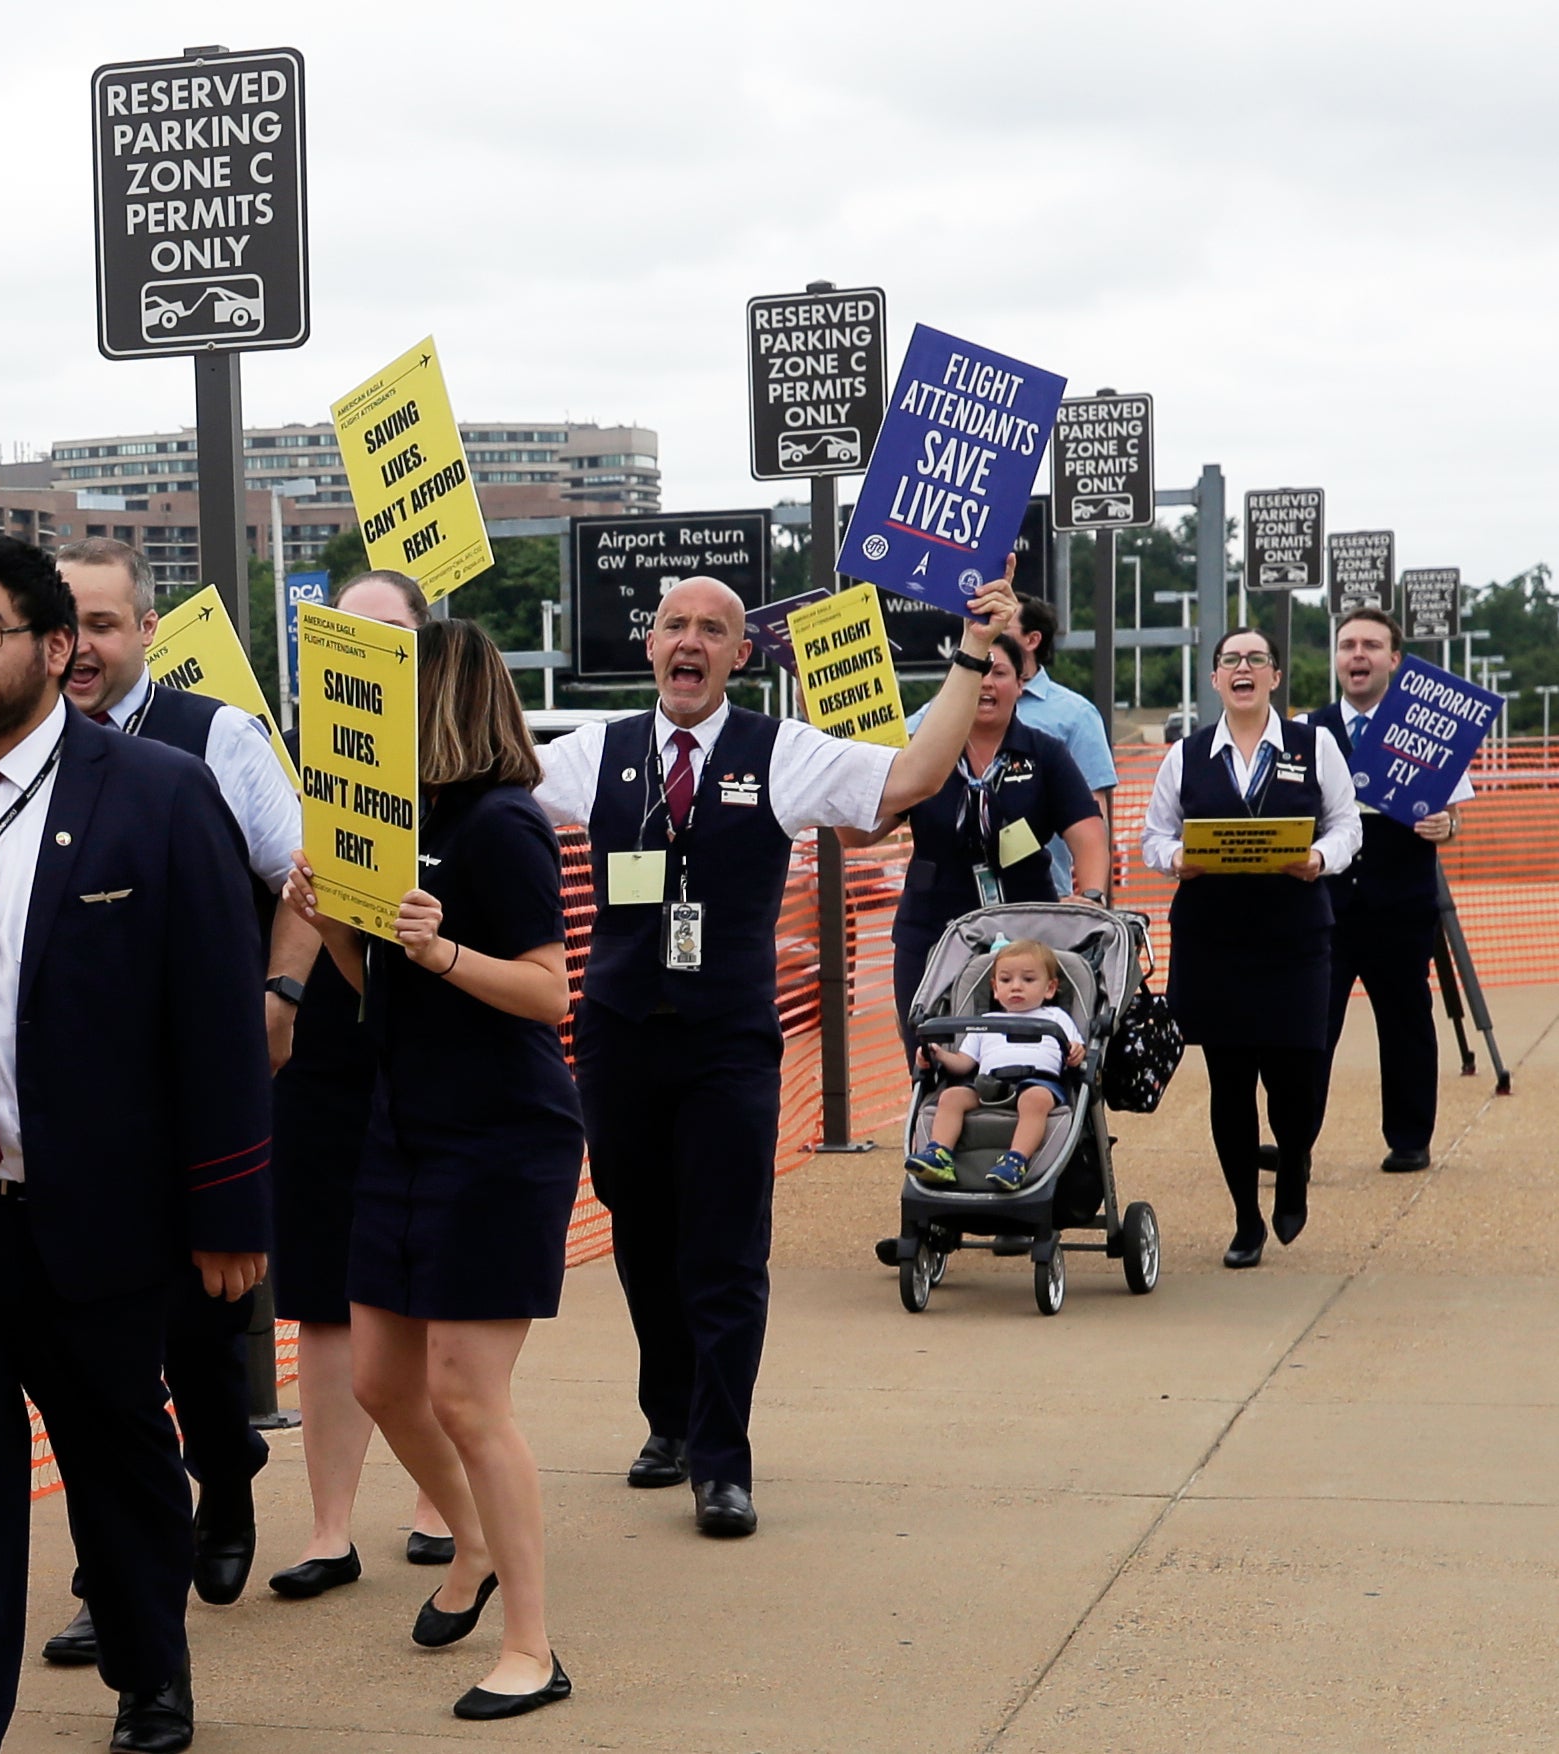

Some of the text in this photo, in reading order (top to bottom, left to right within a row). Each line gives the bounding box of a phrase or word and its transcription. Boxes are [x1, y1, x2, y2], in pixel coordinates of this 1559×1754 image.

[107, 70, 287, 117] RESERVED
[114, 111, 282, 156] PARKING
[126, 152, 273, 195] ZONE C
[126, 192, 274, 235] PERMITS
[151, 234, 250, 273] ONLY
[755, 300, 875, 330] RESERVED
[759, 326, 872, 355] PARKING
[768, 351, 867, 379] ZONE C
[768, 377, 867, 404] PERMITS
[942, 353, 1024, 408] FLIGHT
[337, 380, 385, 417] AMERICAN EAGLE
[341, 388, 397, 430] FLIGHT ATTENDANTS
[1056, 402, 1145, 423] RESERVED
[364, 400, 420, 455] SAVING
[785, 403, 851, 428] ONLY
[899, 380, 1040, 456] ATTENDANTS
[1059, 420, 1142, 441] PARKING
[916, 430, 997, 496] SAVE
[1065, 438, 1139, 459] ZONE C
[381, 443, 427, 488] LIVES.
[1065, 456, 1139, 477] PERMITS
[1077, 475, 1126, 494] ONLY
[363, 458, 466, 544] CAN'T AFFORD
[889, 475, 990, 550] LIVES!
[1250, 493, 1319, 509] RESERVED
[1251, 507, 1317, 522] PARKING
[402, 520, 447, 564] RENT.
[598, 528, 744, 550] Airport Return
[1255, 535, 1313, 550] PERMITS
[1256, 521, 1313, 536] ZONE C
[1331, 535, 1390, 547] RESERVED
[598, 550, 749, 569] GW Parkway South
[1264, 549, 1303, 562] ONLY
[1333, 547, 1388, 559] PARKING
[1337, 558, 1385, 570] ZONE C
[620, 585, 634, 596] To
[1336, 570, 1385, 582] PERMITS
[1344, 582, 1377, 592] ONLY
[289, 584, 323, 600] DCA
[304, 614, 335, 632] AMERICAN
[335, 622, 356, 636] EAGLE
[805, 618, 871, 660] PSA FLIGHT
[304, 633, 366, 659] FLIGHT ATTENDANTS
[807, 646, 883, 690] ATTENDANTS
[324, 668, 383, 716] SAVING
[819, 677, 884, 716] DESERVE A
[1399, 670, 1492, 727] CORPORATE
[857, 703, 899, 732] WAGE.
[1404, 702, 1458, 741] GREED
[332, 723, 380, 767] LIVES.
[1383, 723, 1453, 770] DOESN'T
[1387, 758, 1420, 787] FLY
[303, 766, 413, 830] CAN'T AFFORD
[335, 827, 378, 872] RENT.
